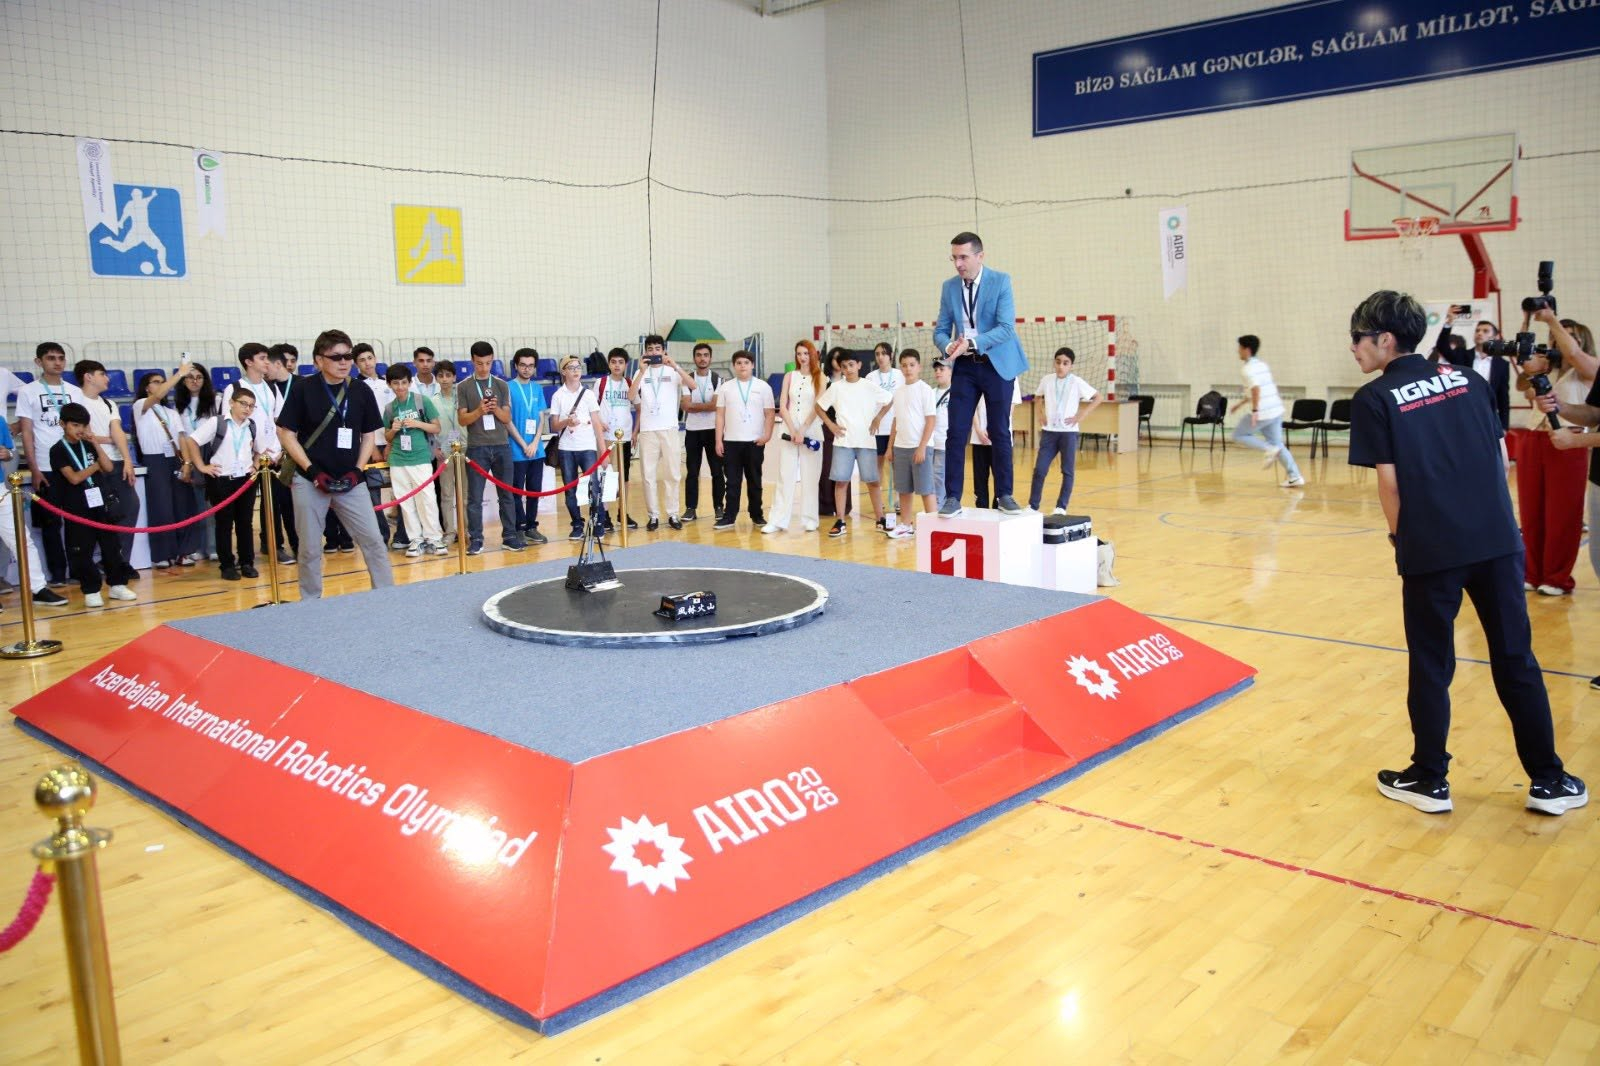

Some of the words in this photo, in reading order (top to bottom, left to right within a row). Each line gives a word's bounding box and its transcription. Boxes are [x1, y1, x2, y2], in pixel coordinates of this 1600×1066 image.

[1074, 76, 1114, 95] BİZƏ
[1120, 61, 1197, 88] SAĞLAM
[1203, 44, 1304, 75] GƏNCLƏR,
[1311, 24, 1408, 57] SAĞLAM
[1416, 4, 1519, 39] MİLLƏT,
[1173, 234, 1185, 260] AIRO
[1390, 370, 1469, 405] IGNIS
[1399, 400, 1424, 413] ROBOT
[1424, 394, 1446, 405] SUMO
[1446, 386, 1469, 398] TEAM
[941, 538, 967, 578] 1
[1149, 633, 1171, 648] 20
[1163, 645, 1184, 660] 26
[1106, 638, 1170, 680] AIRO
[89, 663, 170, 711] Azerbaijan
[162, 694, 290, 762] International
[274, 739, 386, 807] Robotics
[382, 783, 538, 868] Olymad
[787, 766, 823, 792] 20
[804, 785, 839, 812] 26
[692, 778, 808, 854] AIRO
